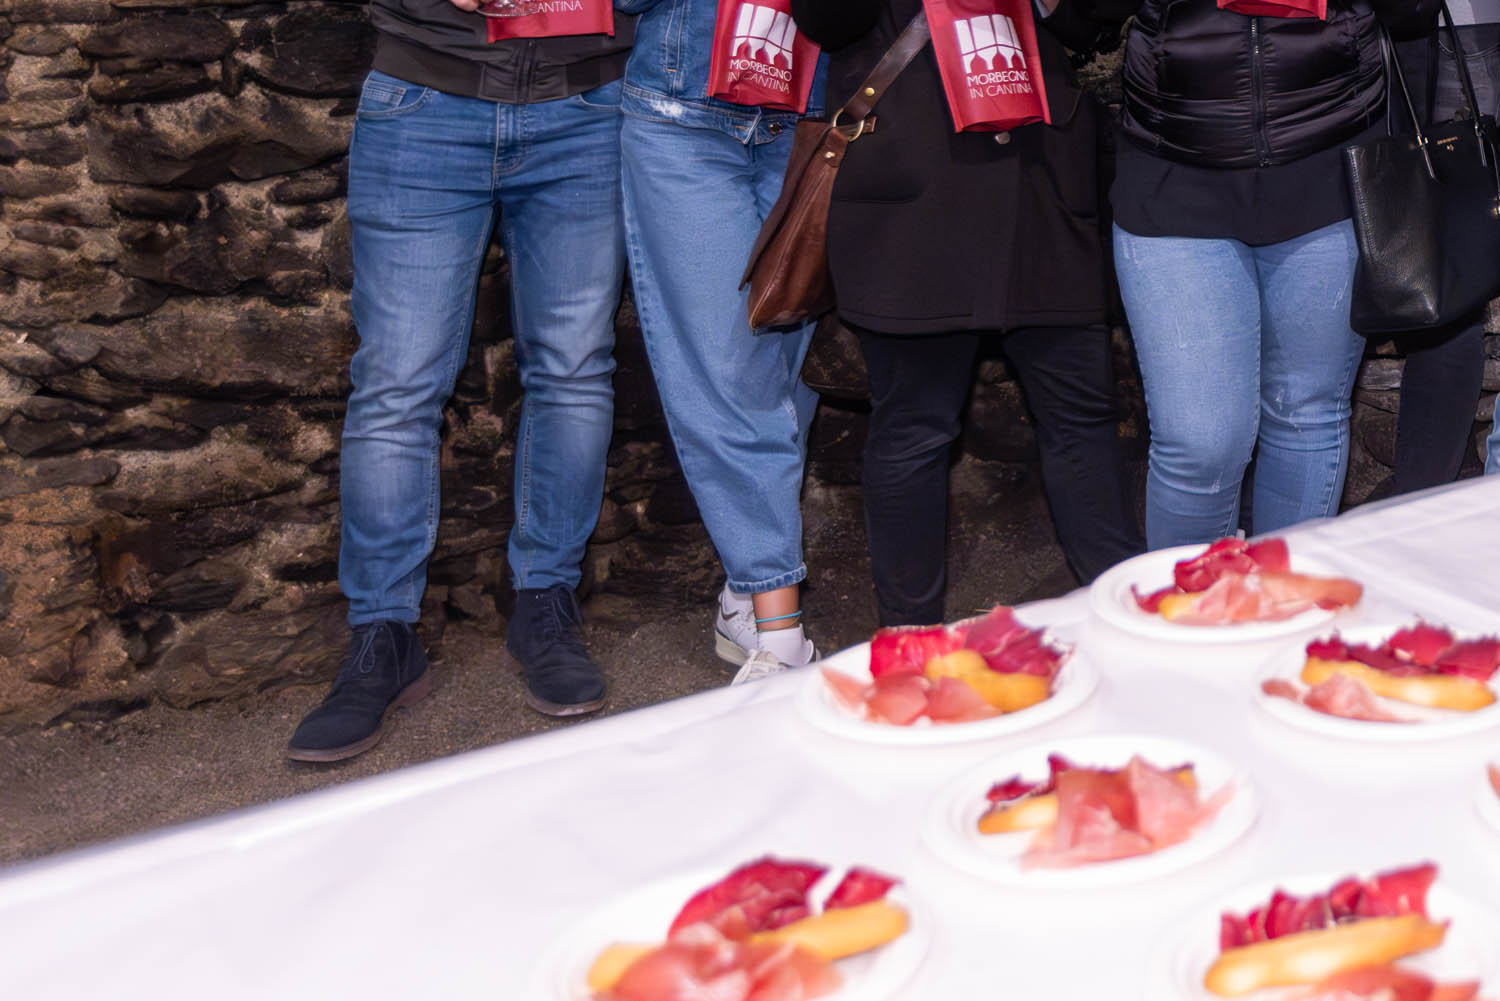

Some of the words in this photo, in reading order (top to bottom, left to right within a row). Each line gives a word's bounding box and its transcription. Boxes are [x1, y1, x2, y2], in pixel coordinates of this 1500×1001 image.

[730, 59, 793, 82] MORBEGNO
[728, 71, 741, 83] IN
[743, 72, 791, 94] CANTINA
[970, 86, 984, 99] IN
